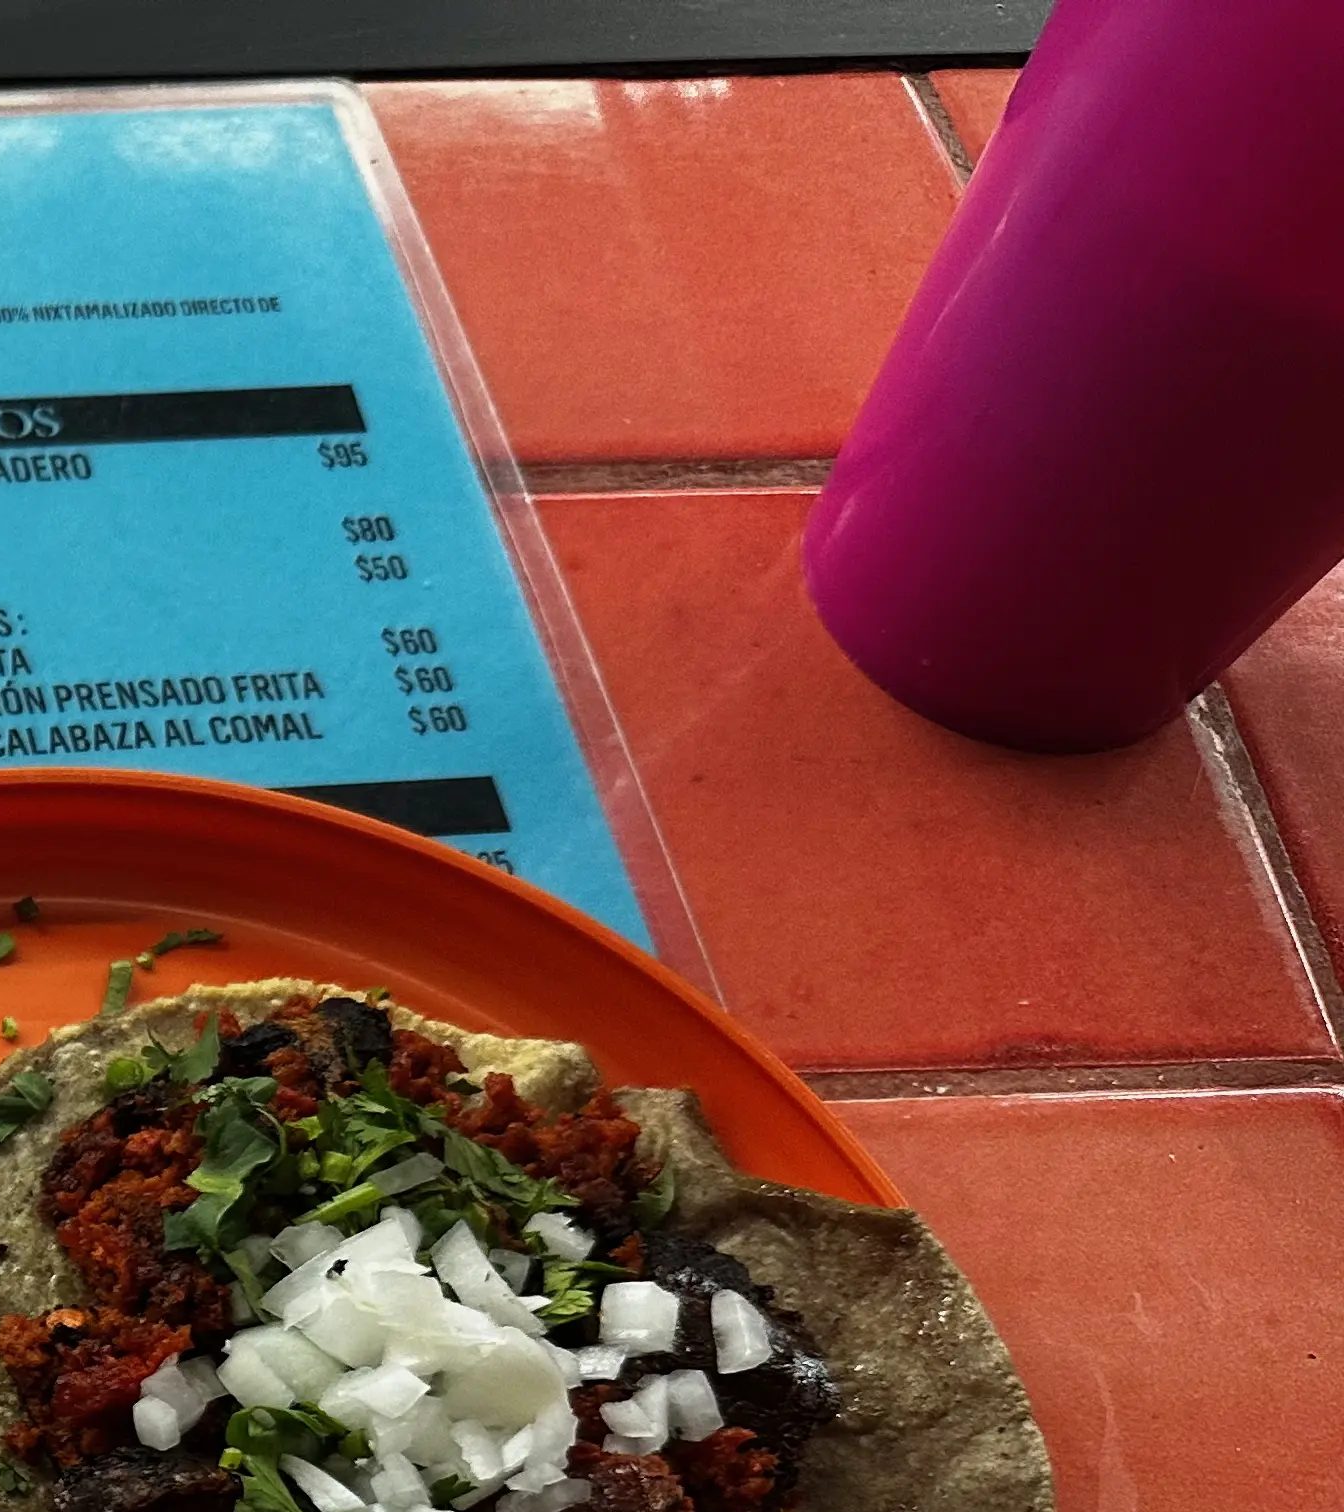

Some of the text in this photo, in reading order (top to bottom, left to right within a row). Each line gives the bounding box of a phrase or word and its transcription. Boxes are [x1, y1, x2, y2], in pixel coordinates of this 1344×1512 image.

[32, 301, 177, 322] NIXTAMALIZADO
[179, 297, 254, 317] DIRECTO
[257, 295, 281, 313] DE
[318, 441, 369, 469] $95
[341, 515, 396, 544] $80
[355, 554, 409, 583] $50
[381, 627, 438, 657] $60
[52, 675, 227, 713] PRENSADO
[231, 671, 325, 703] FRITA
[395, 665, 455, 696] $60
[164, 718, 206, 748] AL
[208, 712, 324, 745] COMAL
[407, 705, 468, 736] $60
